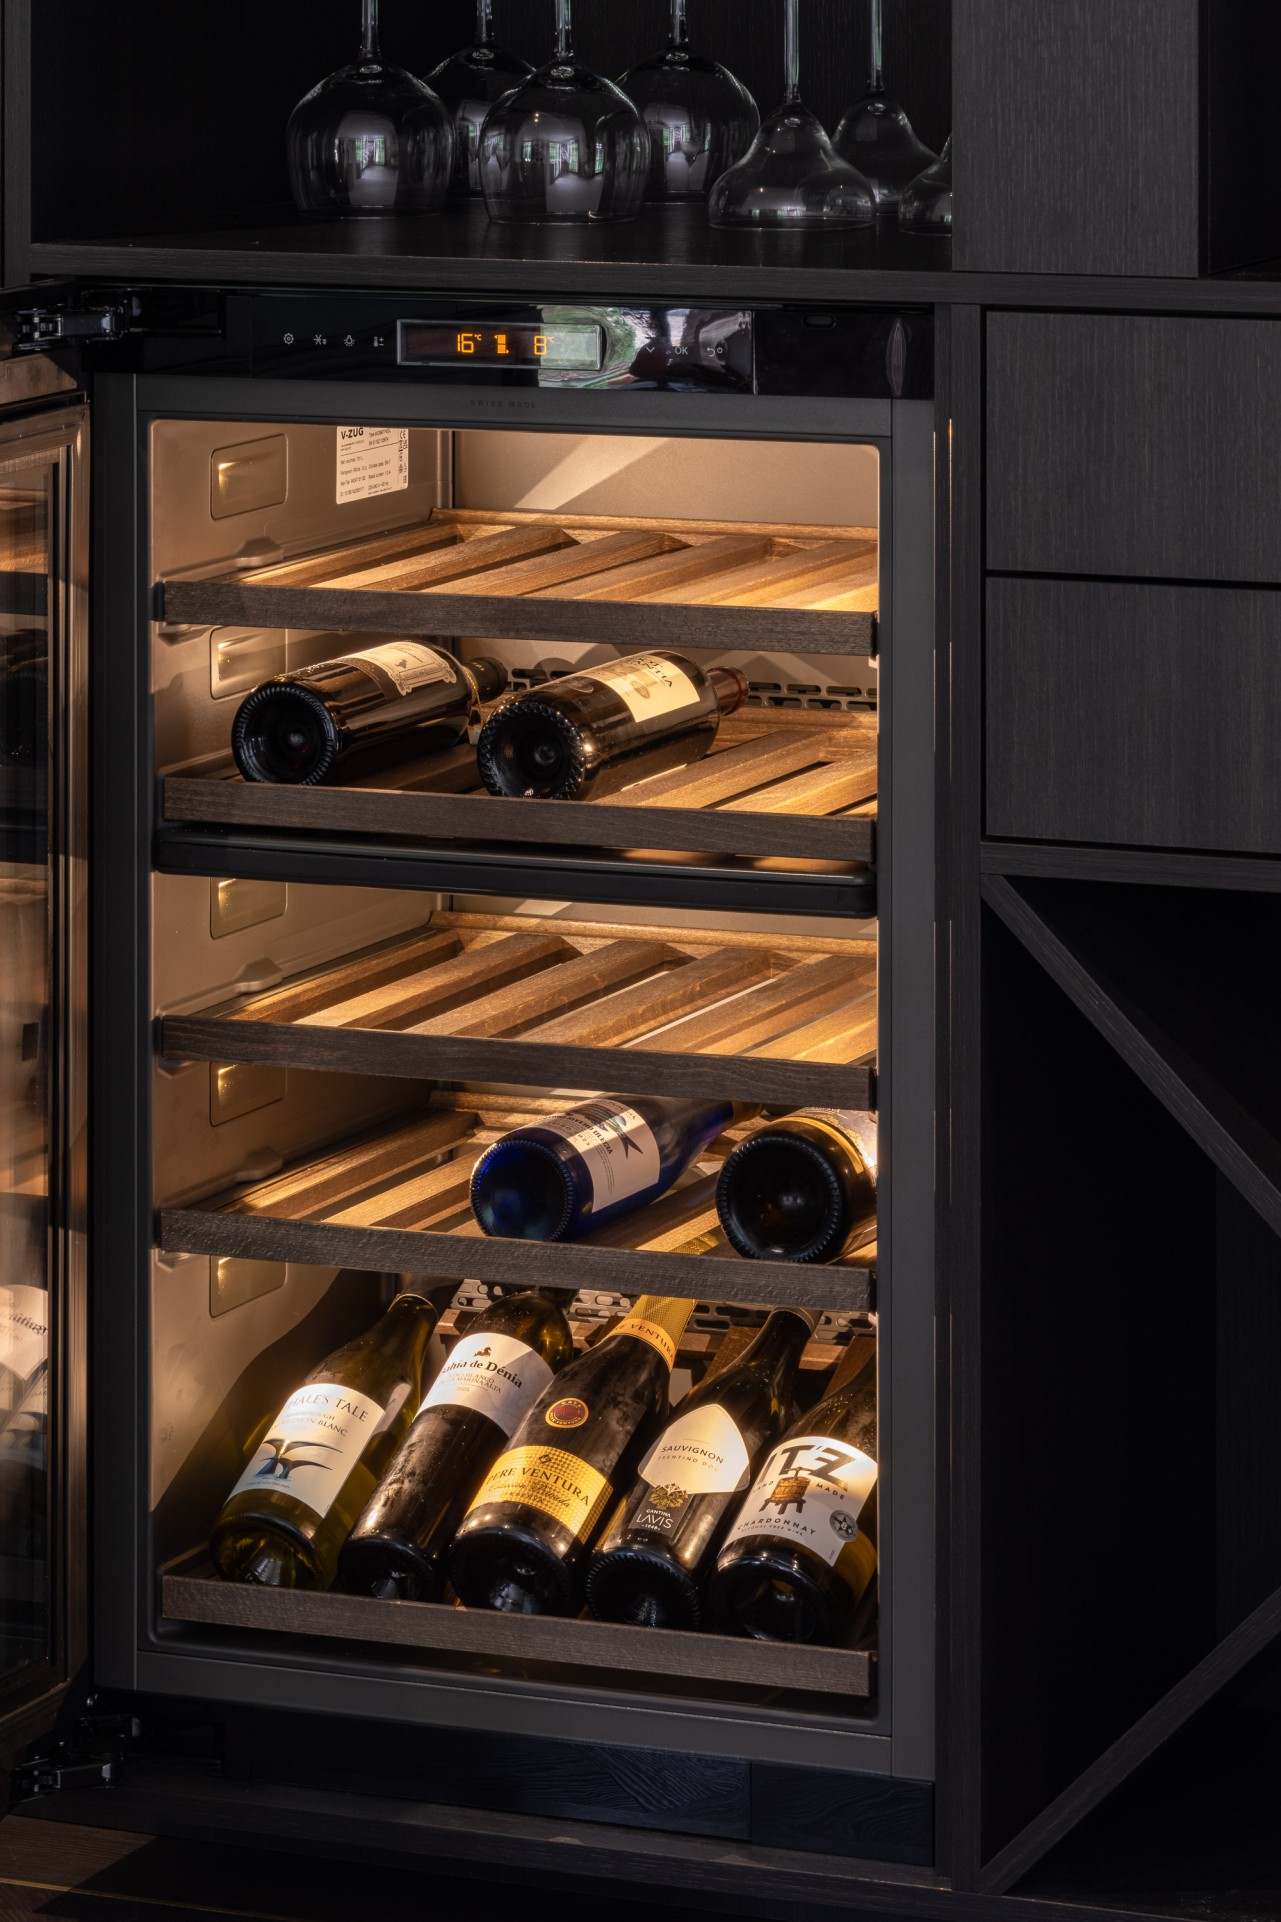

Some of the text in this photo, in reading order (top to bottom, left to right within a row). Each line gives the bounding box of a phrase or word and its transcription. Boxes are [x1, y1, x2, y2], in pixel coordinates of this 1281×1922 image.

[674, 346, 688, 355] OK
[341, 427, 364, 440] V-ZUG
[469, 1360, 483, 1369] de
[485, 1361, 522, 1389] Dénia
[335, 1397, 369, 1423] TALE
[318, 1420, 348, 1437] BLANC
[661, 1445, 724, 1464] SAUVIGNON
[521, 1467, 590, 1506] VENTURA
[816, 1482, 846, 1501] MADE
[636, 1513, 674, 1530] LAVIS
[645, 1508, 671, 1518] CANTINA
[737, 1517, 817, 1536] CHARDONNAY
